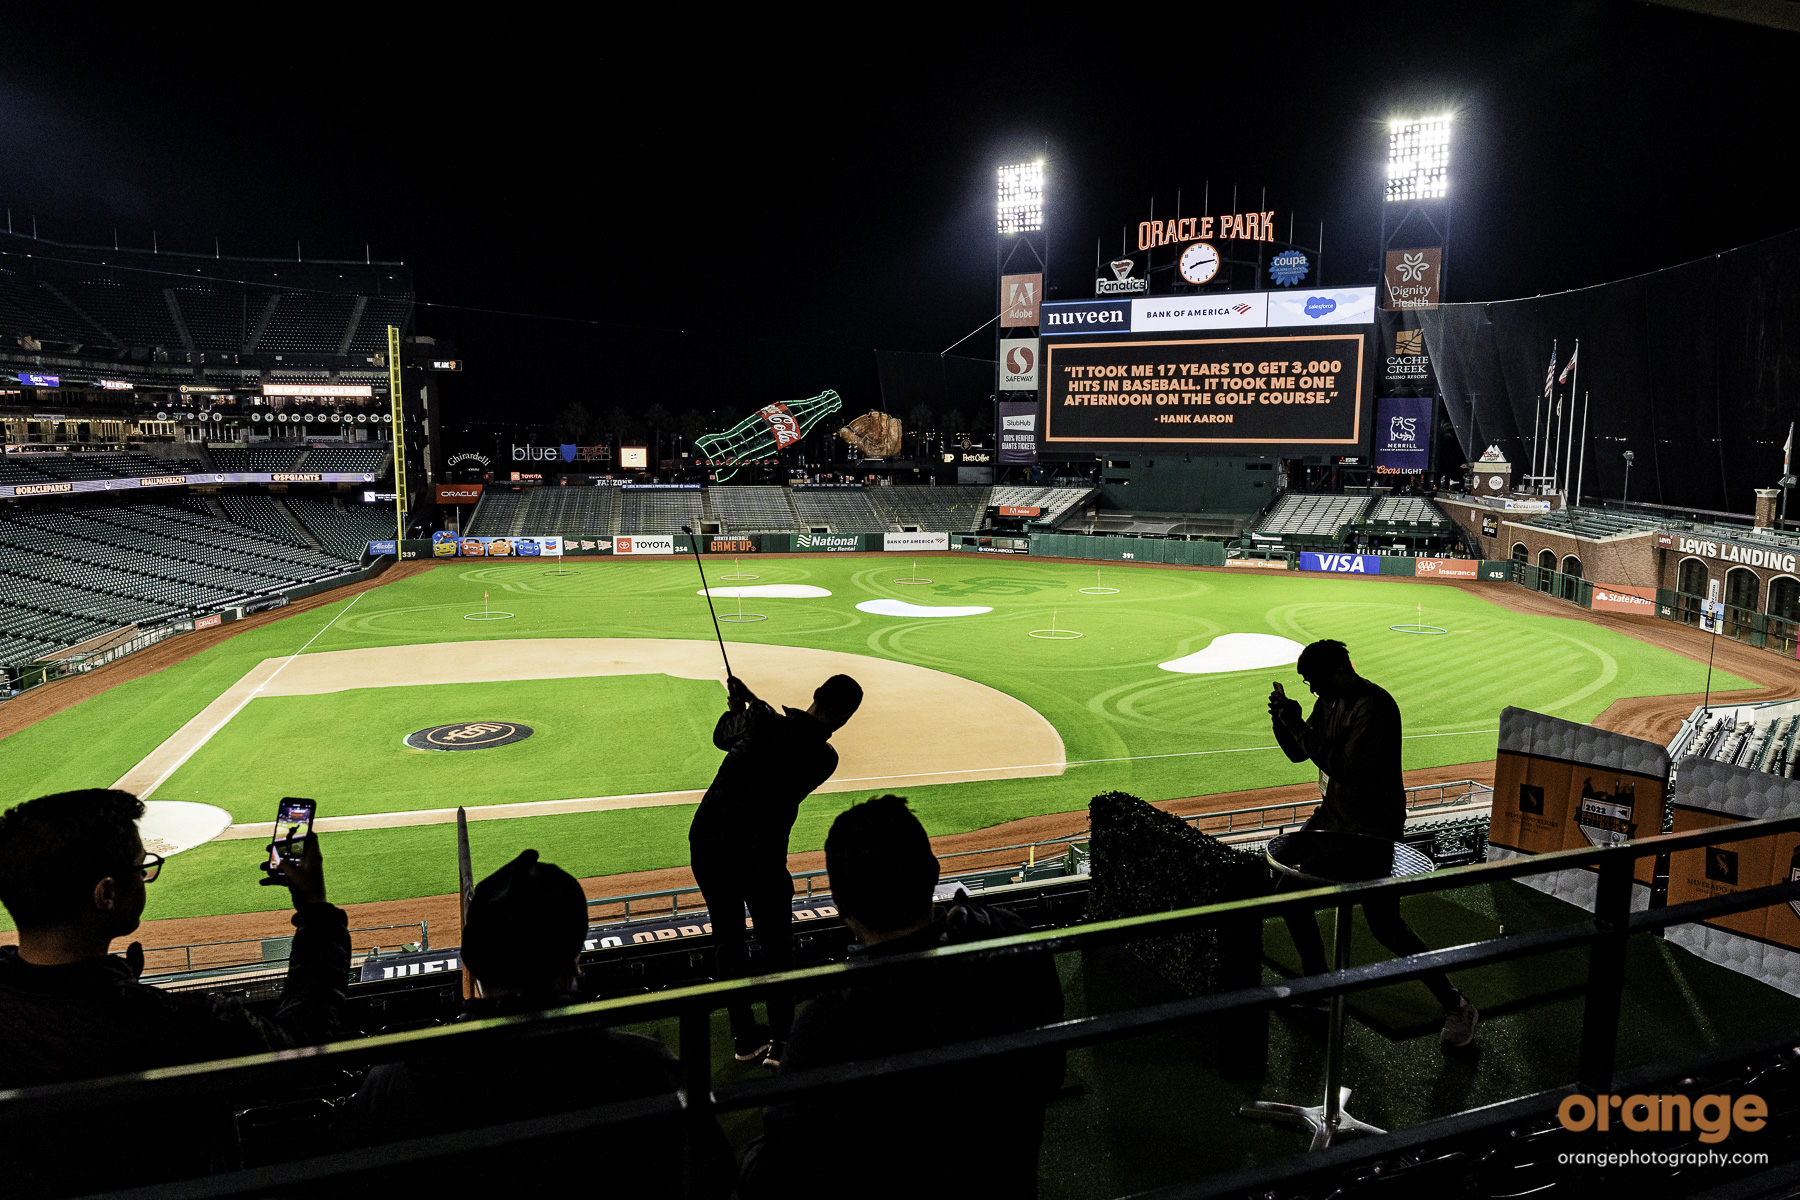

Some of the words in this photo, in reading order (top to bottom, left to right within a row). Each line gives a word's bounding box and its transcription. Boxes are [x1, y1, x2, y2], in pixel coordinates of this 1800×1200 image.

[1138, 217, 1214, 251] ORACLE
[1220, 211, 1275, 242] PARK
[1274, 256, 1306, 268] coupa
[1097, 279, 1144, 291] Fanatics
[1391, 285, 1432, 298] Dignity
[1392, 297, 1429, 308] Health
[1009, 310, 1032, 320] Adobe
[1047, 310, 1123, 325] nuveen
[1187, 308, 1229, 317] AMERICA
[1386, 356, 1429, 365] CACHE
[1086, 366, 1128, 377] TOOK
[1131, 365, 1153, 377] ME
[1157, 365, 1174, 376] 17
[1180, 363, 1230, 376] YEARS
[1232, 363, 1254, 375] TO
[1257, 362, 1289, 374] GET
[1291, 361, 1341, 375] 3,000
[1387, 365, 1427, 374] CREEK
[1005, 375, 1033, 383] SAFEWAY
[1068, 380, 1100, 392] HITS
[1103, 380, 1118, 392] IN
[1122, 379, 1200, 391] BASEBALL.
[1203, 378, 1219, 390] IT
[1220, 377, 1266, 390] TOOK
[1270, 377, 1294, 389] ME
[1298, 376, 1334, 389] ONE
[1063, 393, 1152, 406] AFTERNOON
[1155, 393, 1179, 405] ON
[1181, 393, 1211, 405] THE
[1214, 392, 1255, 404] GOLF
[1006, 419, 1031, 427] StubHub
[1160, 414, 1191, 423] HANK
[1192, 414, 1233, 423] AARON
[1015, 434, 1035, 442] VERIFIED
[1002, 442, 1017, 450] GIANTS
[1018, 442, 1036, 450] TICKETS
[512, 444, 557, 461] blue
[447, 452, 491, 467] Ghirardelli
[1376, 465, 1401, 474] Coors
[635, 541, 671, 549] TOYOTA
[811, 535, 857, 546] National
[710, 541, 737, 552] GAME
[1356, 548, 1391, 556] WELCOME
[1314, 554, 1365, 573] VISA
[1720, 544, 1796, 573] LANDING
[1438, 568, 1476, 577] Insurance
[1488, 571, 1503, 579] 415
[198, 616, 219, 629] ORACLE
[1585, 804, 1607, 814] 2022
[1687, 878, 1728, 894] SILVERADO
